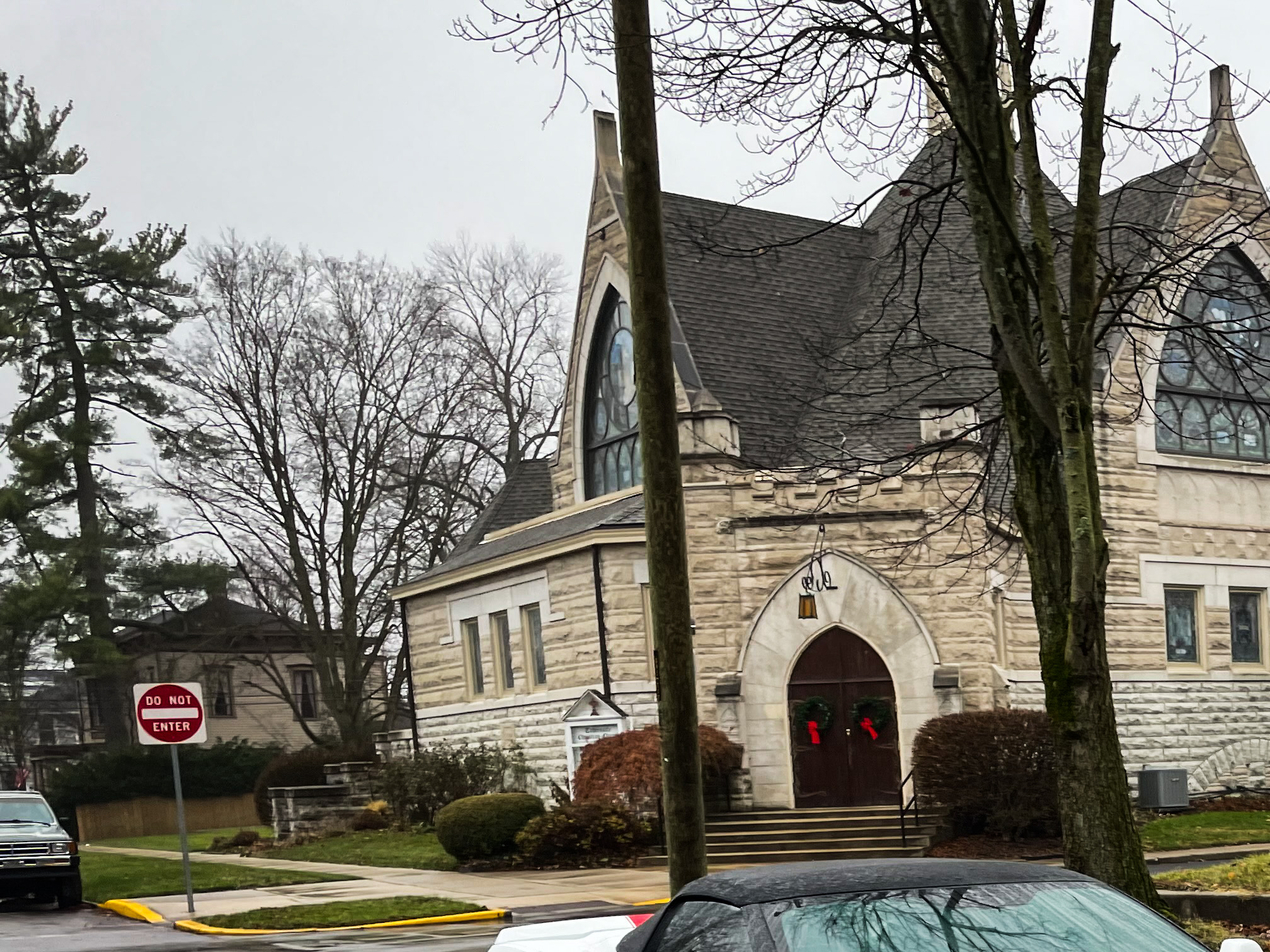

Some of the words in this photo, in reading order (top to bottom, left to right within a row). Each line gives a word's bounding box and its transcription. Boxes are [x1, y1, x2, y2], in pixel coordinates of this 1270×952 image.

[146, 696, 161, 706] DO
[169, 695, 192, 705] NOT
[152, 721, 191, 732] ENTER
